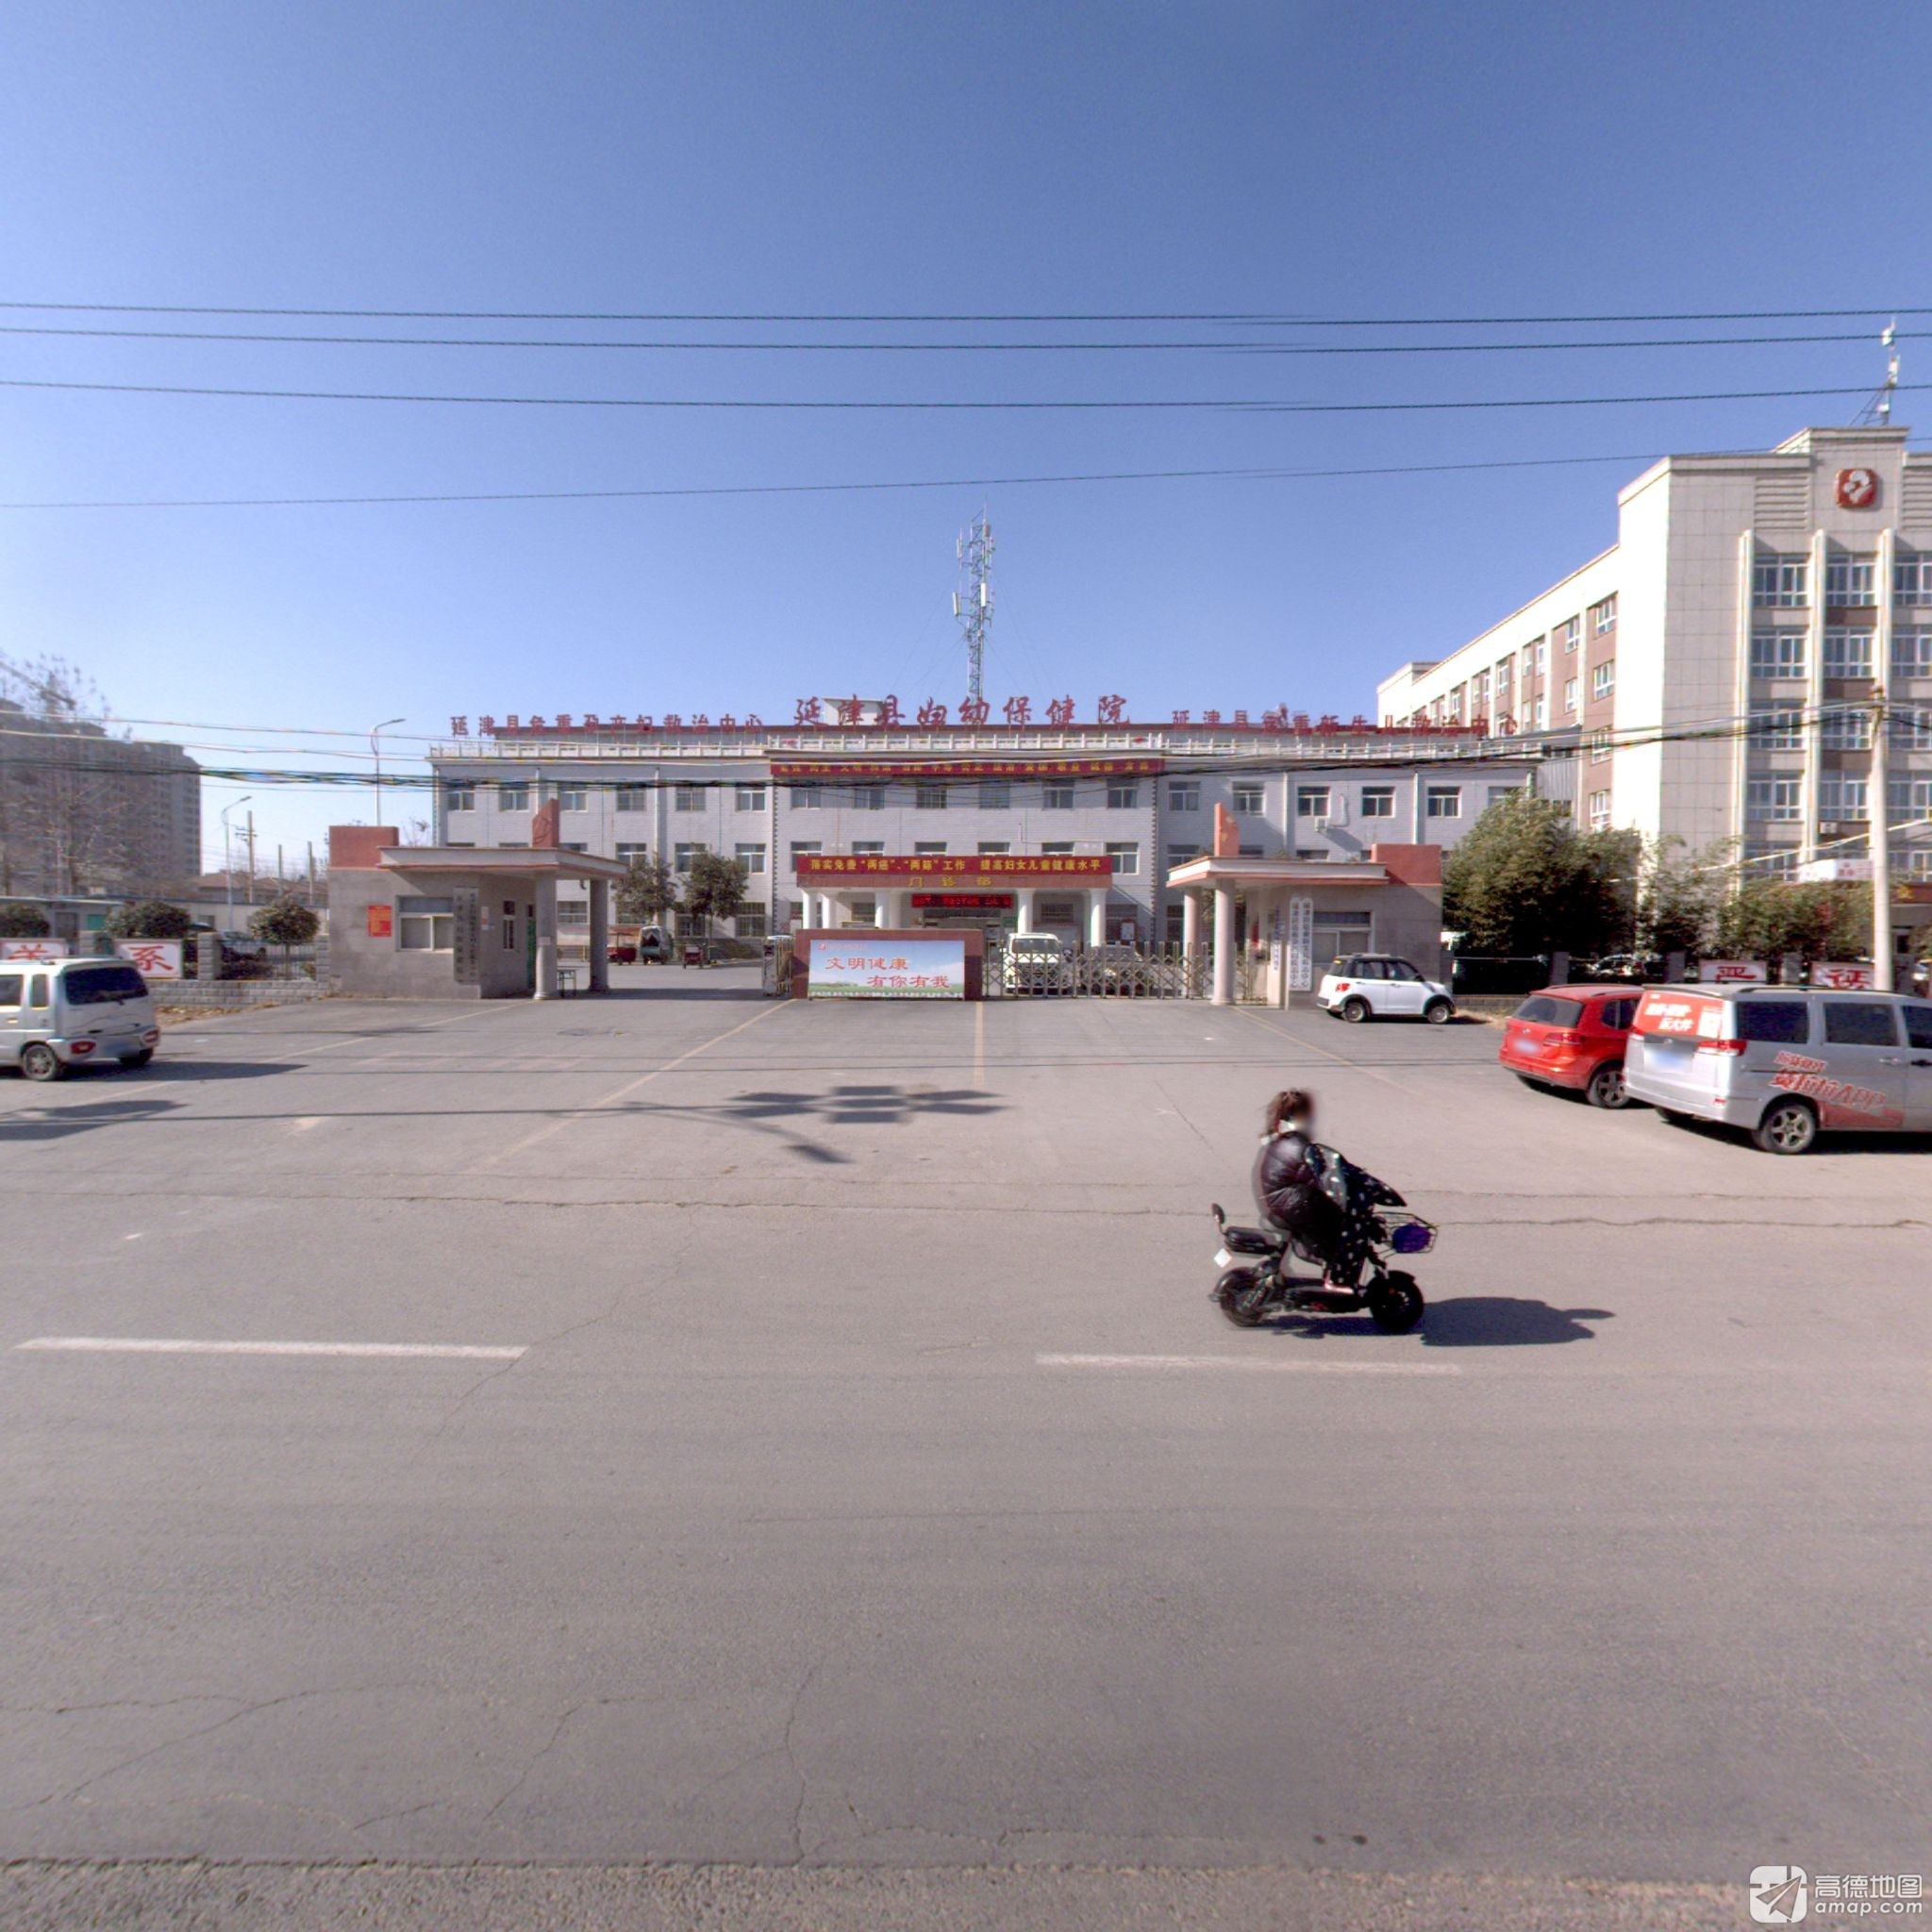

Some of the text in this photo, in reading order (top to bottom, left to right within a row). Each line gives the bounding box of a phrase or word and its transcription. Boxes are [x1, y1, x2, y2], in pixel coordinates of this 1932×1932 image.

[793, 694, 1130, 727] 延津县妇幼保健院
[825, 958, 909, 971] 文明健康
[867, 975, 951, 989] 有你有我
